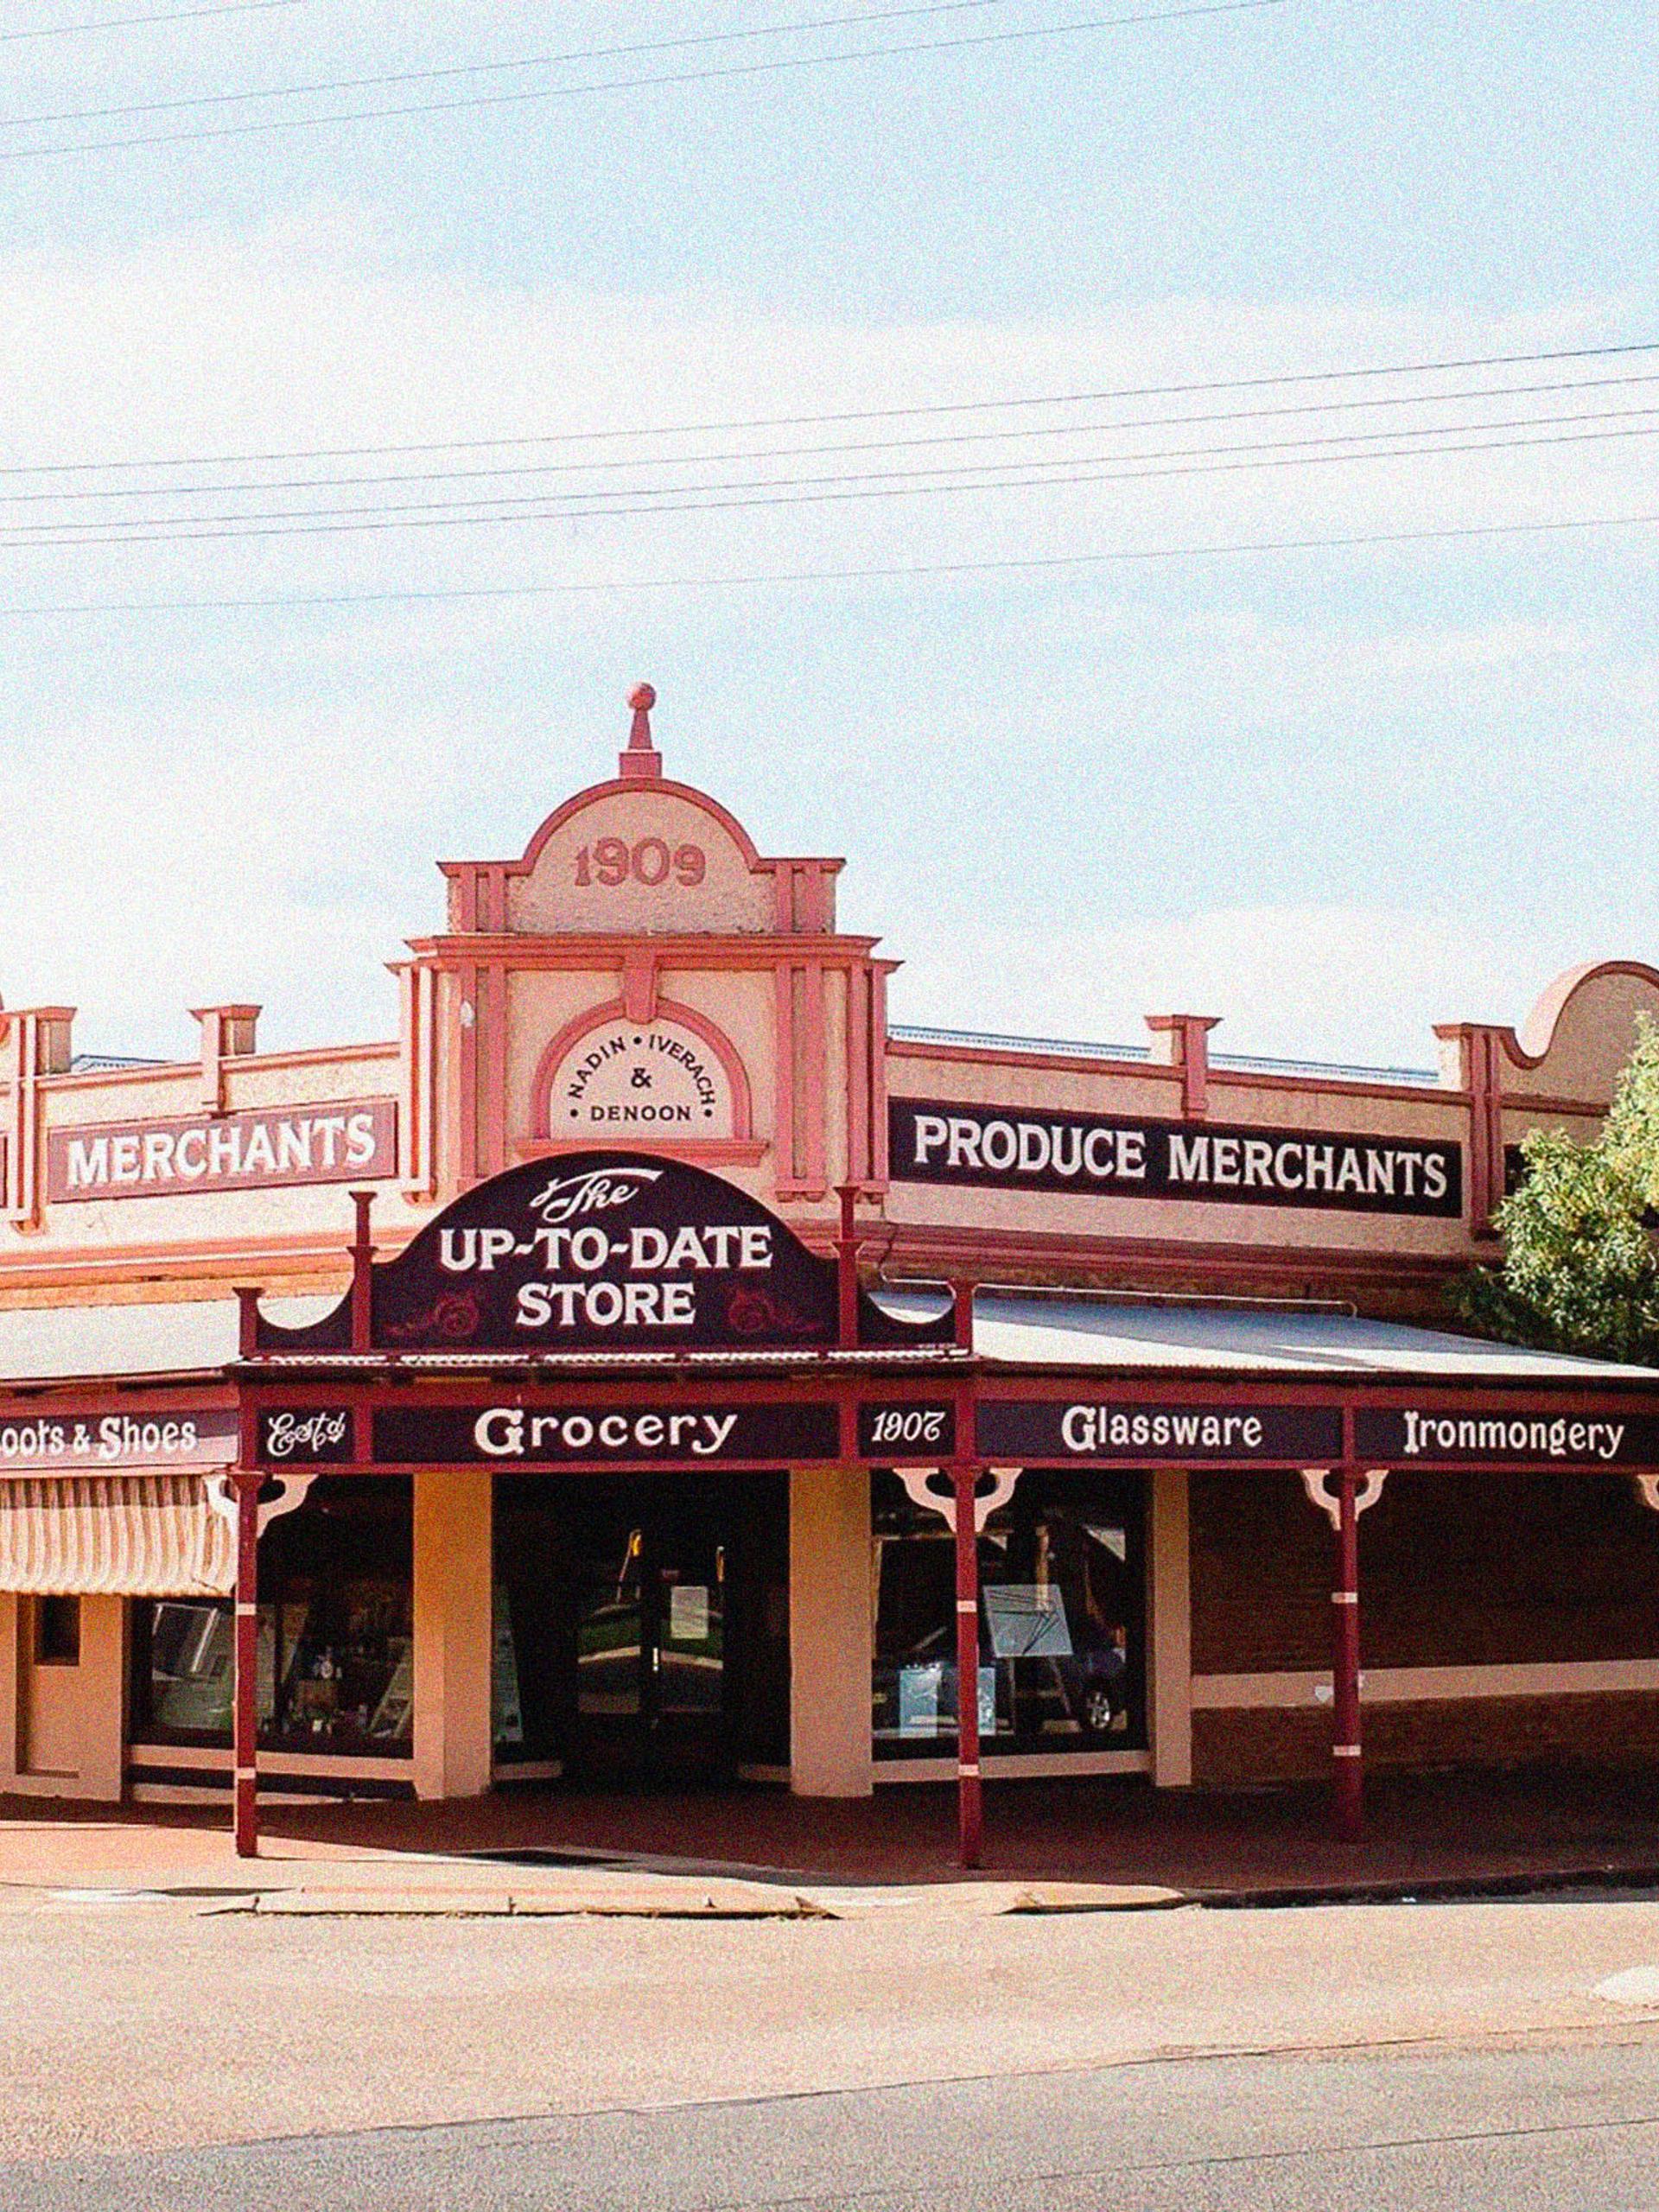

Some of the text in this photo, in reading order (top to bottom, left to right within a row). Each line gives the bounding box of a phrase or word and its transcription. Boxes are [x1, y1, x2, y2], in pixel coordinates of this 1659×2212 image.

[575, 837, 706, 887] 1909
[568, 1033, 715, 1105] NADIN IVERACH
[631, 1067, 652, 1089] &
[591, 1105, 691, 1121] DENOON
[67, 1113, 378, 1189] MERCHANTS
[913, 1115, 1446, 1198] PRODUCE MERCHANTS
[529, 1167, 664, 1223] The
[440, 1226, 773, 1271] UP-TO-DATE
[516, 1282, 696, 1326] STORE
[73, 1423, 92, 1454] &
[99, 1416, 197, 1459] Shoes
[474, 1408, 738, 1455] Grocery
[870, 1412, 946, 1441] 1907
[1061, 1405, 1262, 1452] Glassware
[1403, 1410, 1624, 1459] Ironmongery
